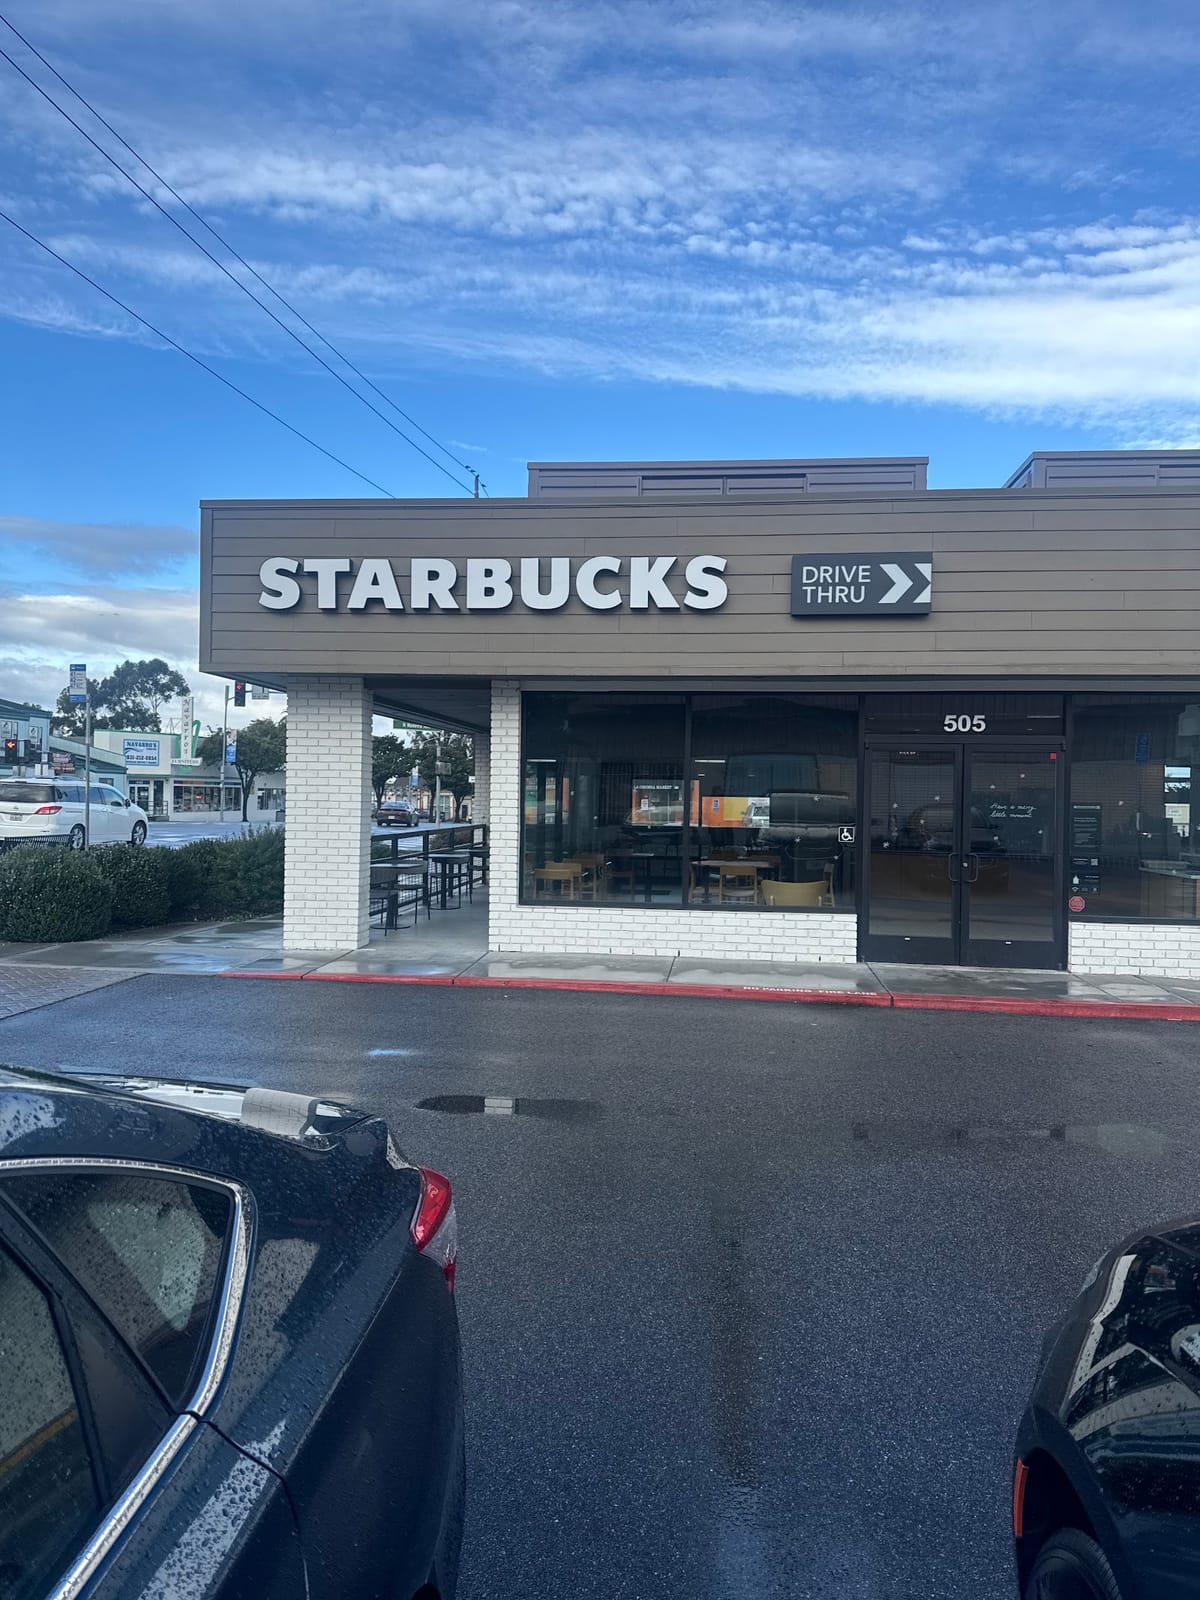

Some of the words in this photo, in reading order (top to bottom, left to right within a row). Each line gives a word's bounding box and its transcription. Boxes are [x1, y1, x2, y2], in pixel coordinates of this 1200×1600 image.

[258, 555, 728, 610] STARBUCKS
[802, 565, 871, 583] DRIVE
[802, 586, 865, 603] THRU
[943, 714, 986, 732] 505
